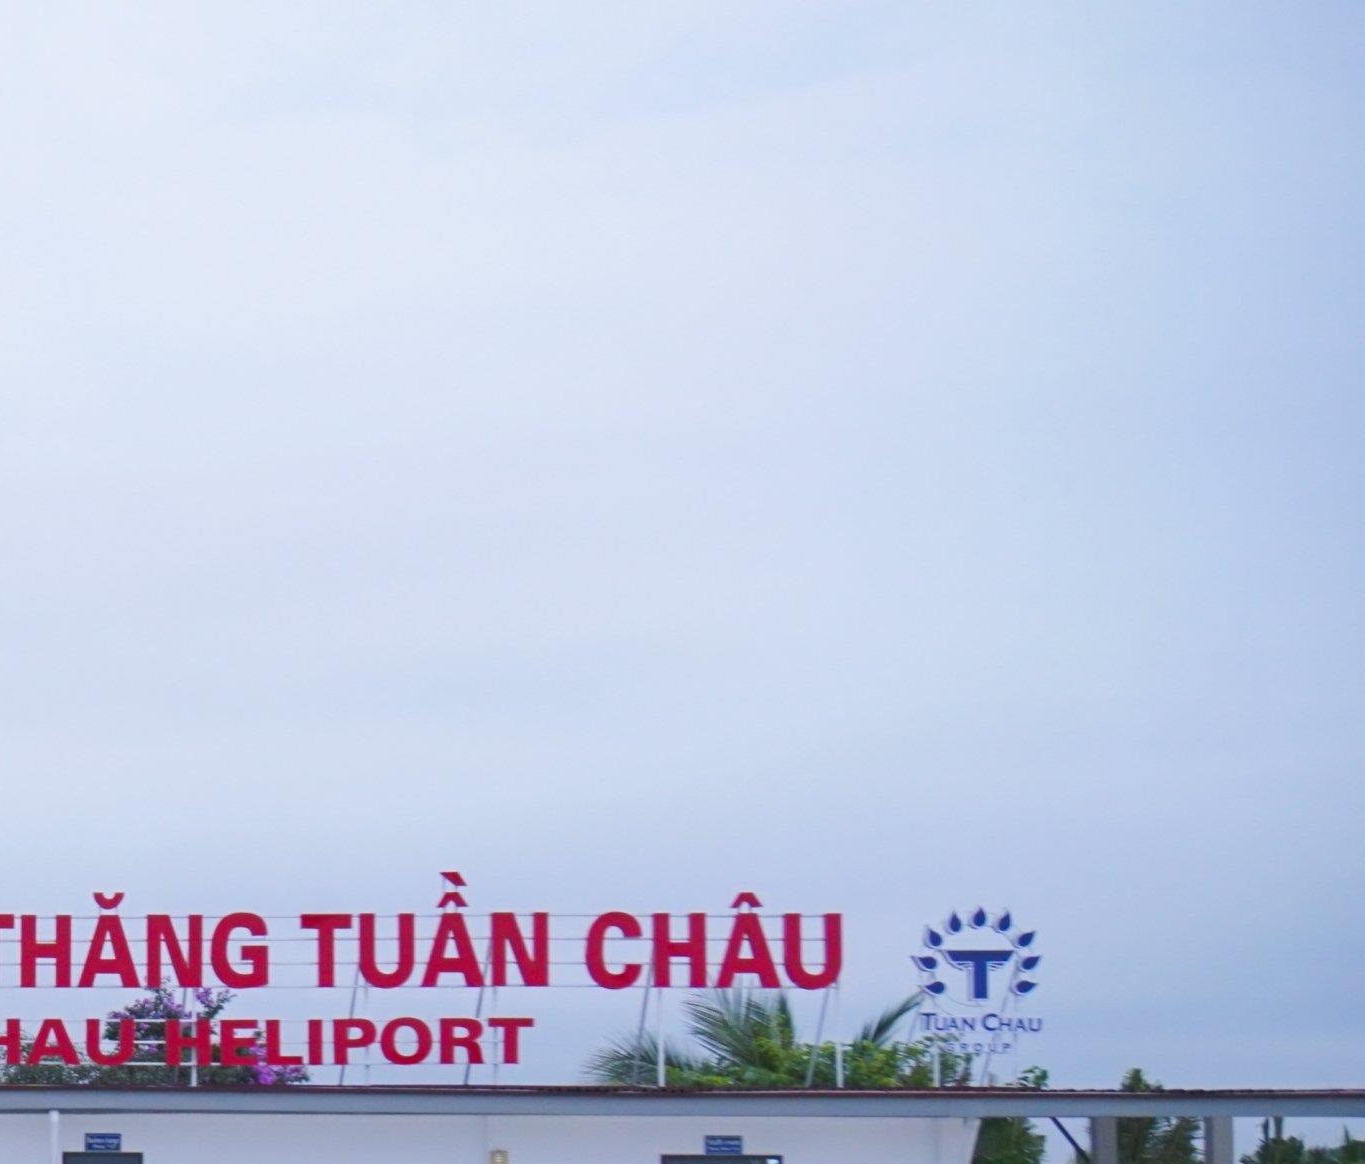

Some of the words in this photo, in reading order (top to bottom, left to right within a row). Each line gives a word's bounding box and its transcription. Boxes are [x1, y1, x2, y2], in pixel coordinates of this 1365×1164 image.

[302, 871, 550, 987] TUẦN
[587, 891, 843, 989] CHÂU
[164, 1017, 532, 1068] HELIPORT
